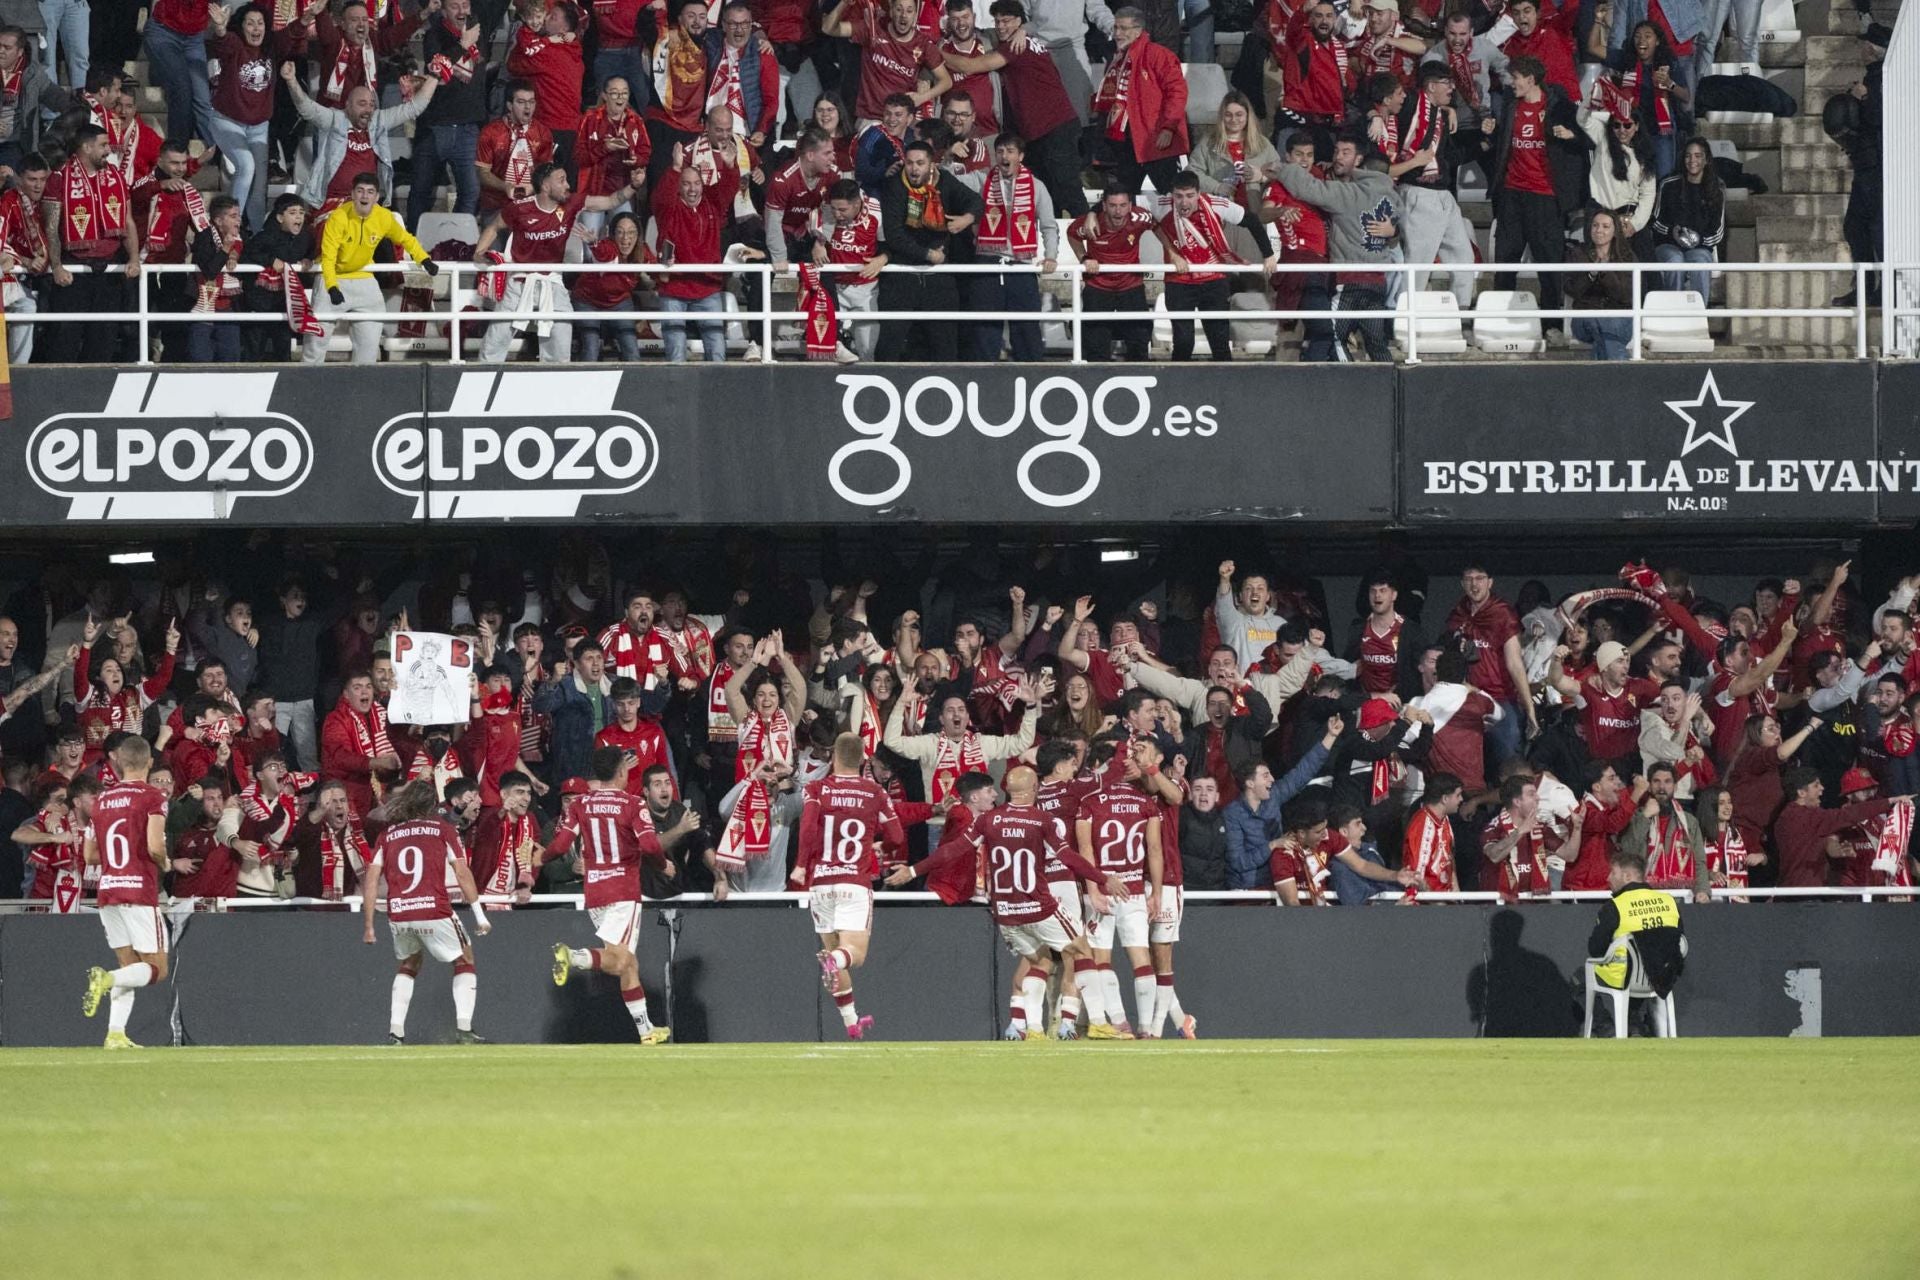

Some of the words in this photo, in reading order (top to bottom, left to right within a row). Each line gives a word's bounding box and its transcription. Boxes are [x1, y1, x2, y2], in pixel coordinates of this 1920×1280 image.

[828, 374, 1218, 507] gougo.es
[1424, 461, 1693, 494] ESTRELLA
[1697, 469, 1729, 484] DE
[395, 634, 413, 663] P
[451, 639, 471, 668] B
[107, 797, 131, 810] MARÍN
[593, 804, 621, 815] BUSTOS
[831, 797, 857, 807] DAVID
[1111, 803, 1140, 814] HÉCTOR
[106, 818, 130, 869] 6
[387, 829, 410, 843] PEDRO
[411, 826, 440, 837] BENITO
[590, 817, 620, 864] 11
[821, 815, 866, 864] 18
[1002, 828, 1025, 838] EKAIN
[1100, 819, 1148, 867] 26
[398, 846, 423, 894] 9
[991, 846, 1036, 893] 20
[1628, 905, 1671, 917] SEGURIDAD
[1630, 898, 1664, 908] HORUS
[1642, 916, 1664, 930] 539
